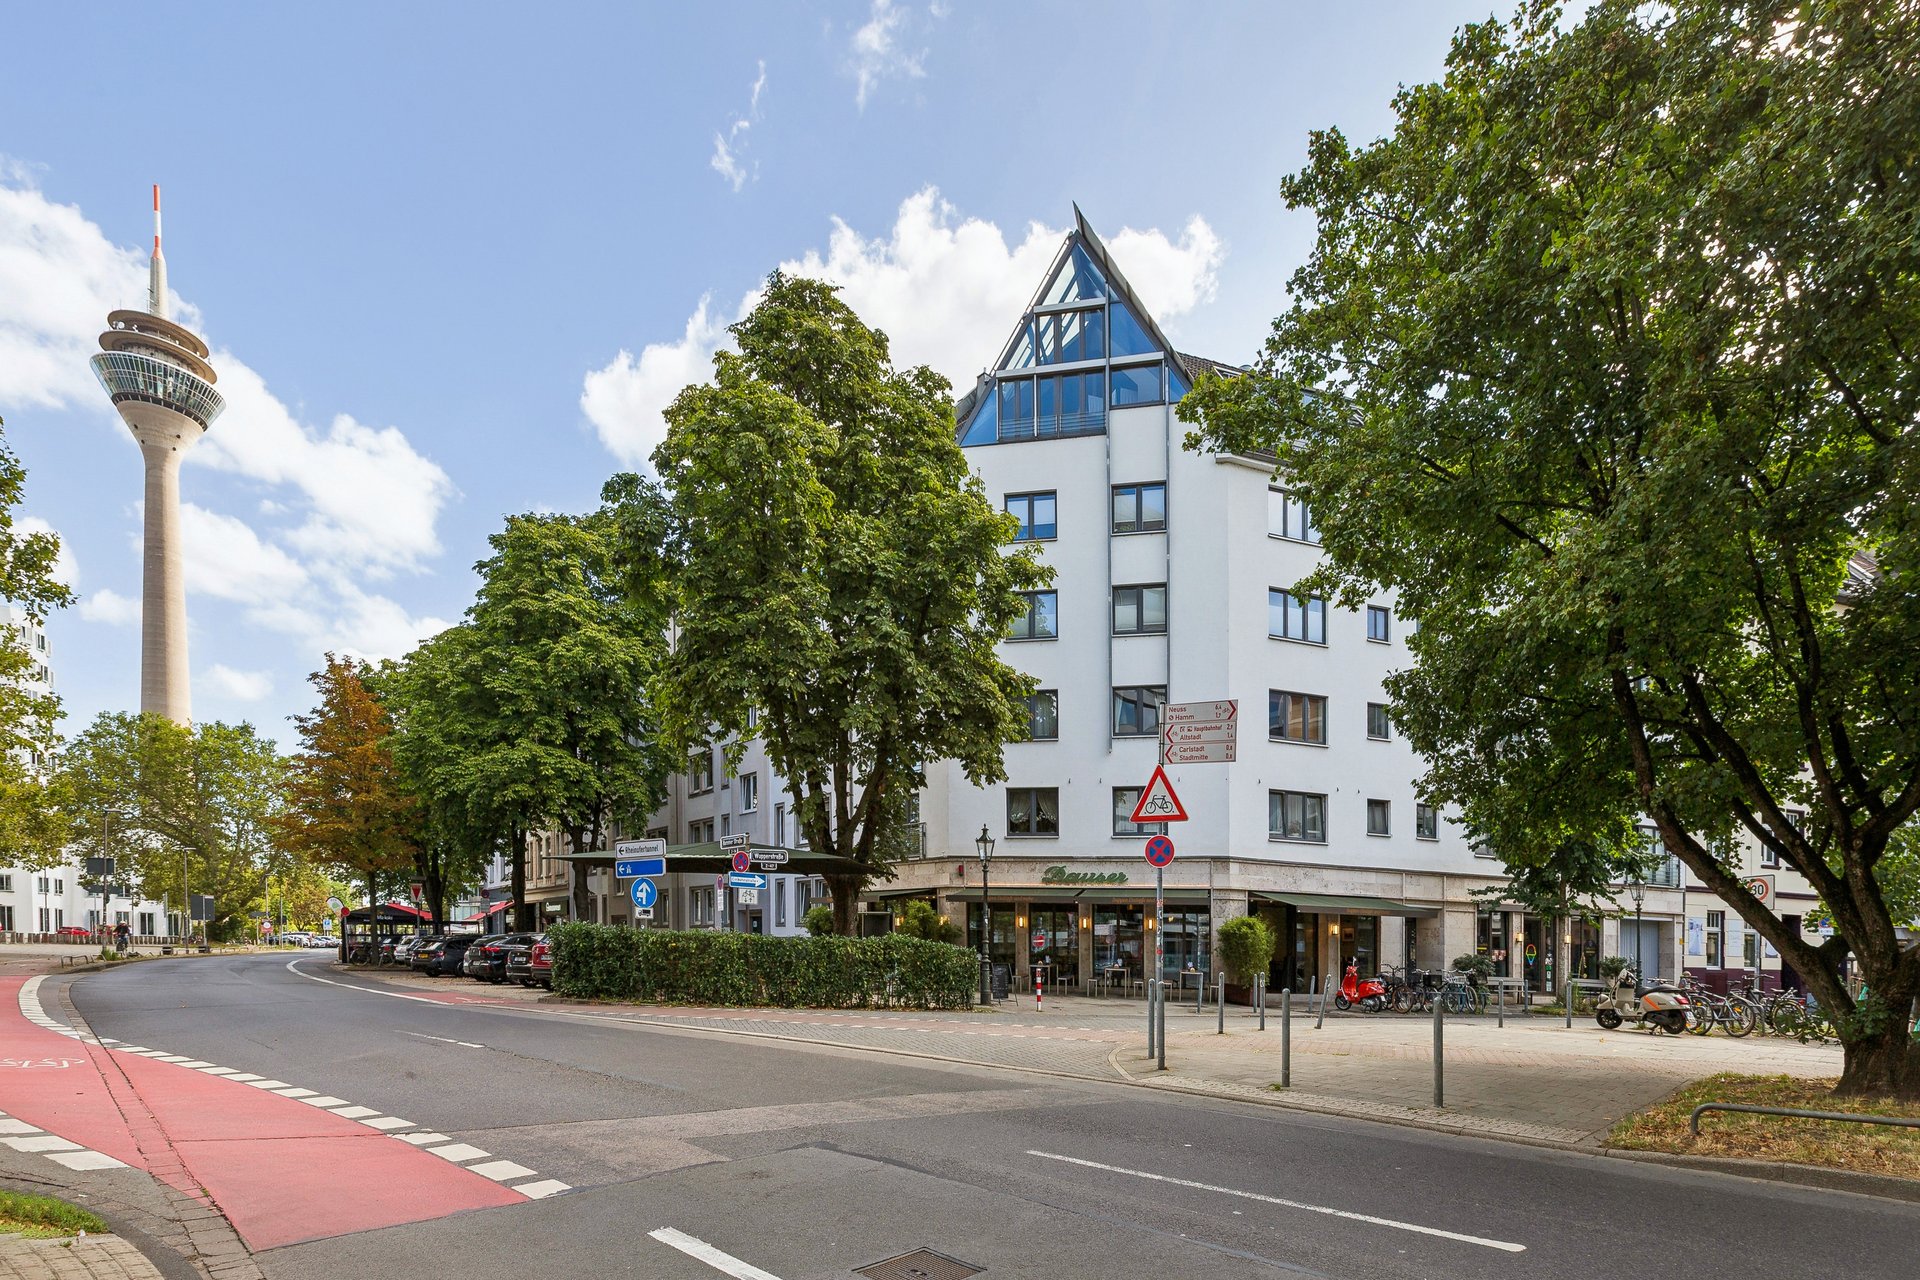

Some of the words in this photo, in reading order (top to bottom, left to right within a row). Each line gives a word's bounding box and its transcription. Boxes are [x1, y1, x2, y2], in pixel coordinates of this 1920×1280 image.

[1193, 724, 1223, 732] Hauptbahnhof
[1179, 745, 1205, 753] Carlstadt
[1179, 753, 1209, 761] Stadtmitte
[625, 844, 659, 853] Rheinufertunnel
[1042, 865, 1129, 883] Dauser
[1751, 884, 1764, 896] 30
